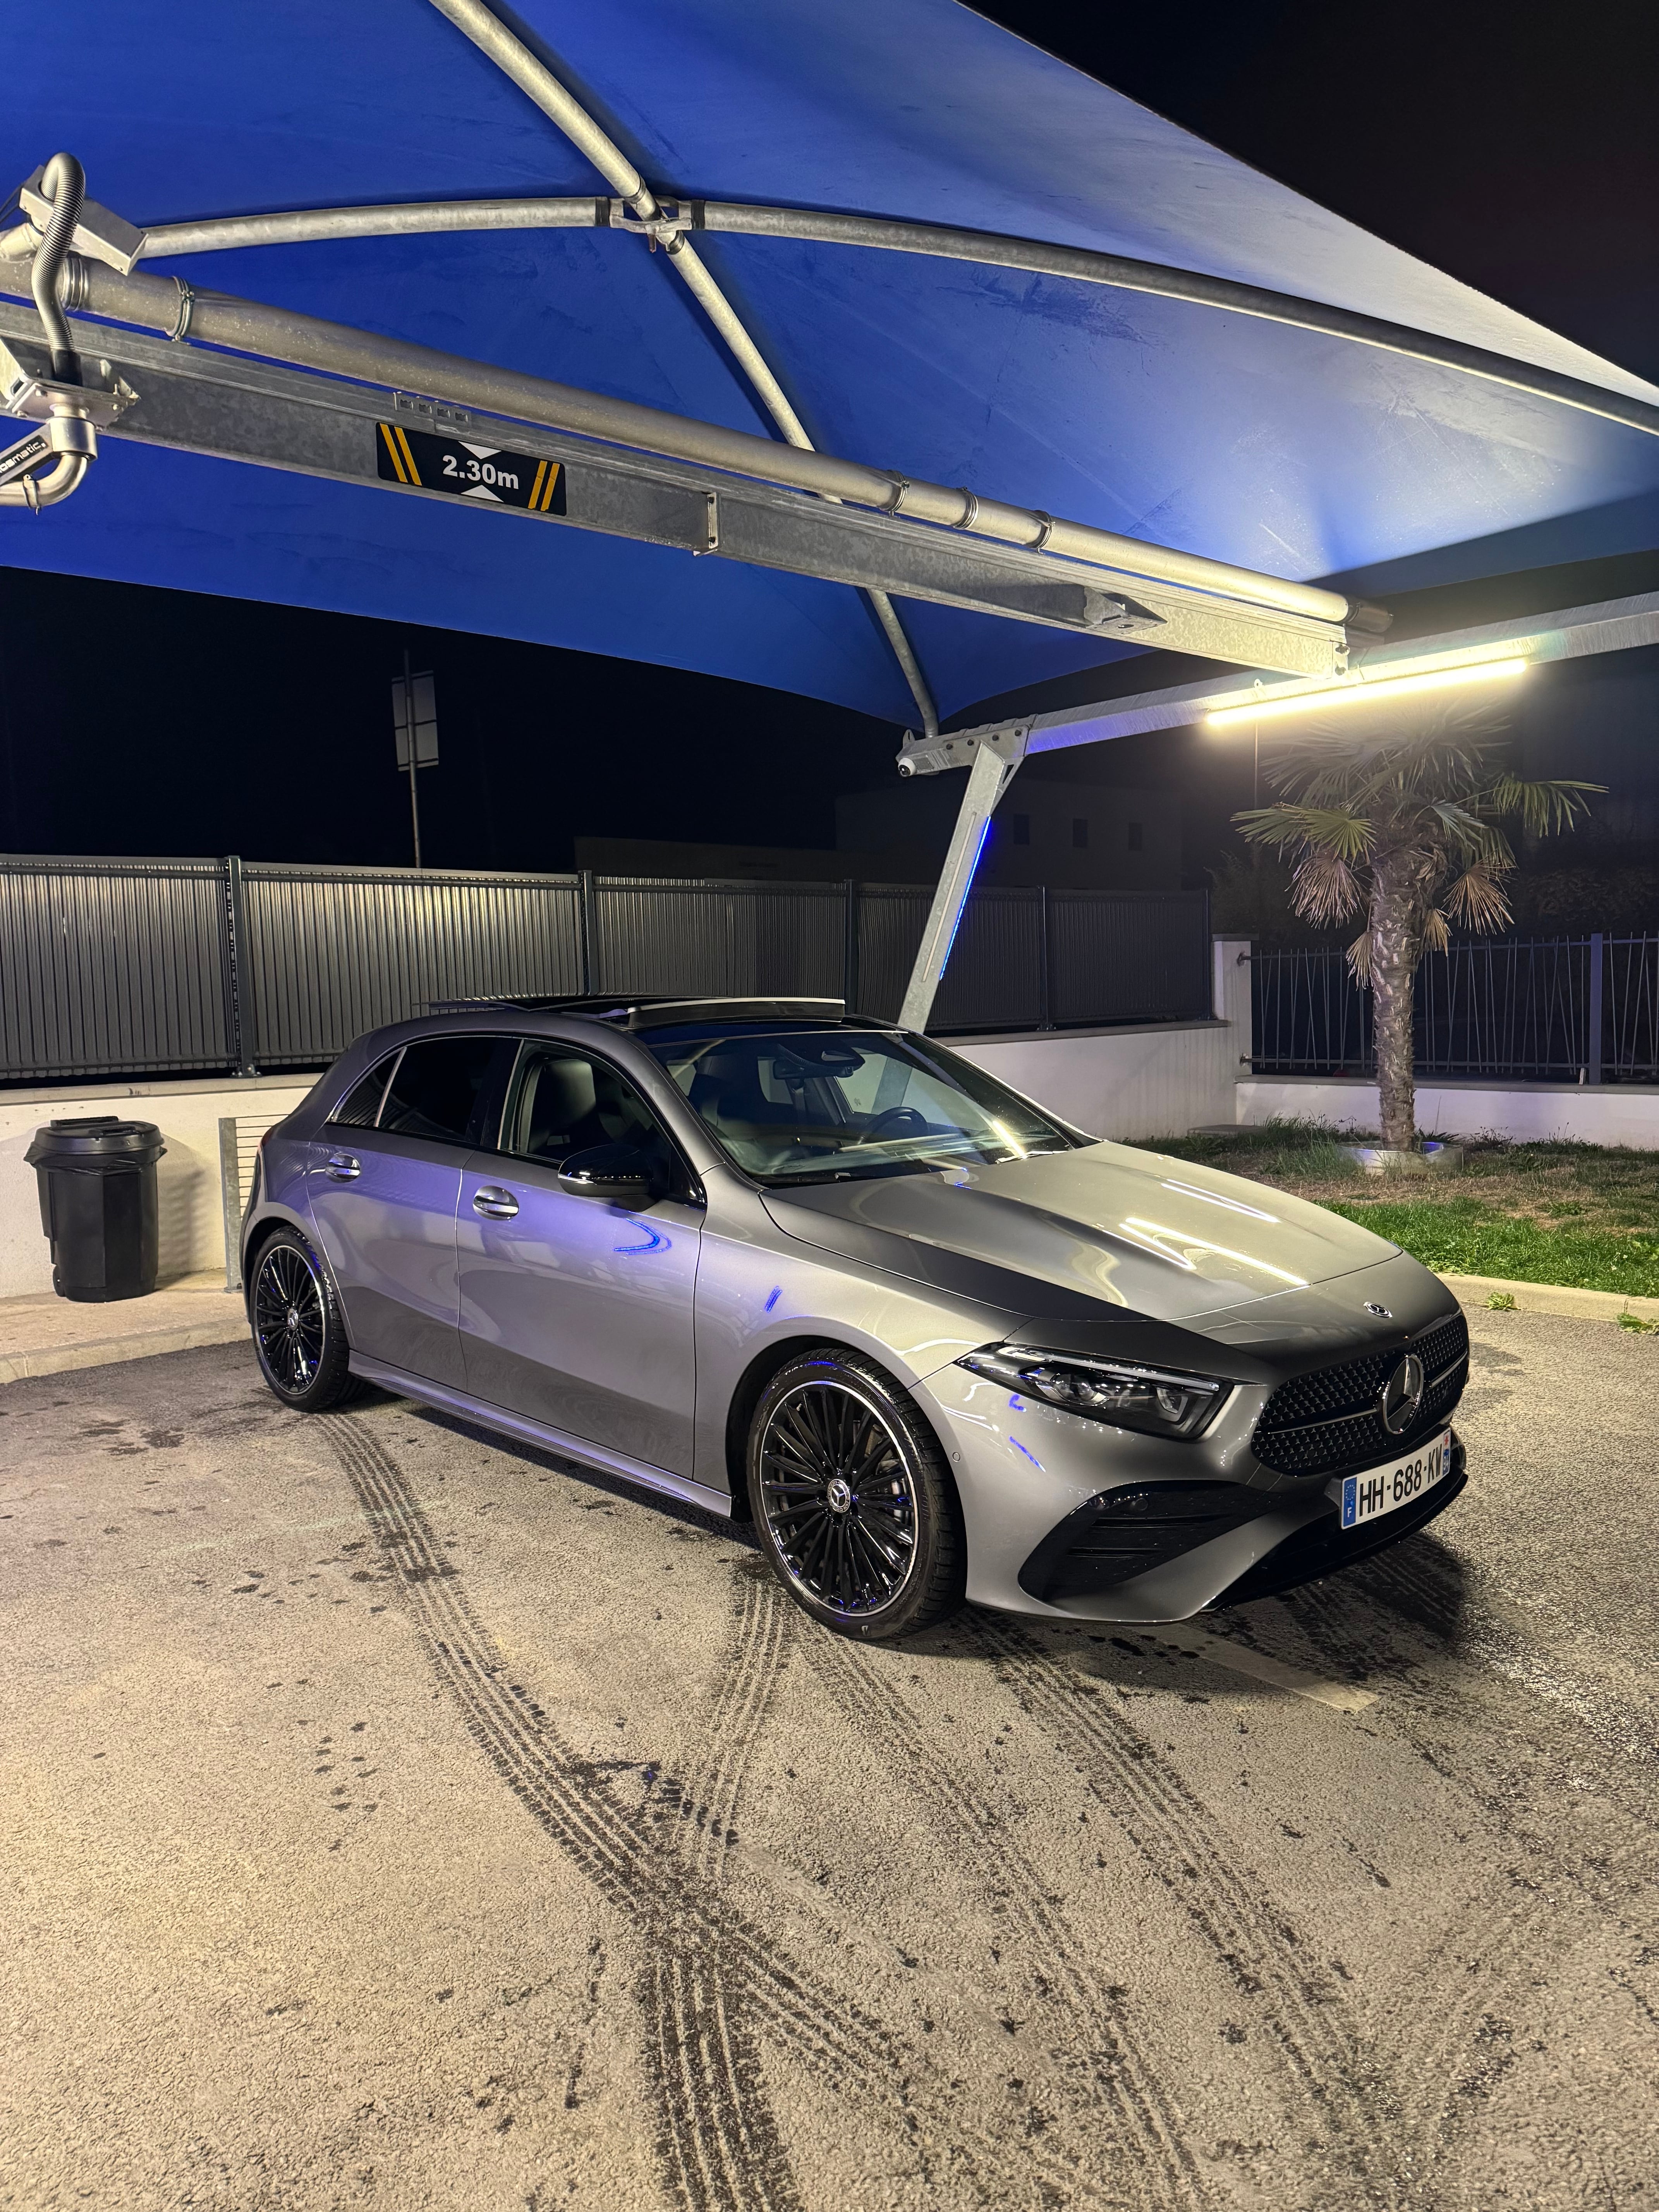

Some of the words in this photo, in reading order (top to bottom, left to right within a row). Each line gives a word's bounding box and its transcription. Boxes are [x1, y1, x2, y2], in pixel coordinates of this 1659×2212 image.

[0, 442, 46, 473] osmatic.
[443, 455, 519, 489] 2.30m
[1359, 1443, 1442, 1517] HH-688-KW
[1347, 1507, 1352, 1518] F
